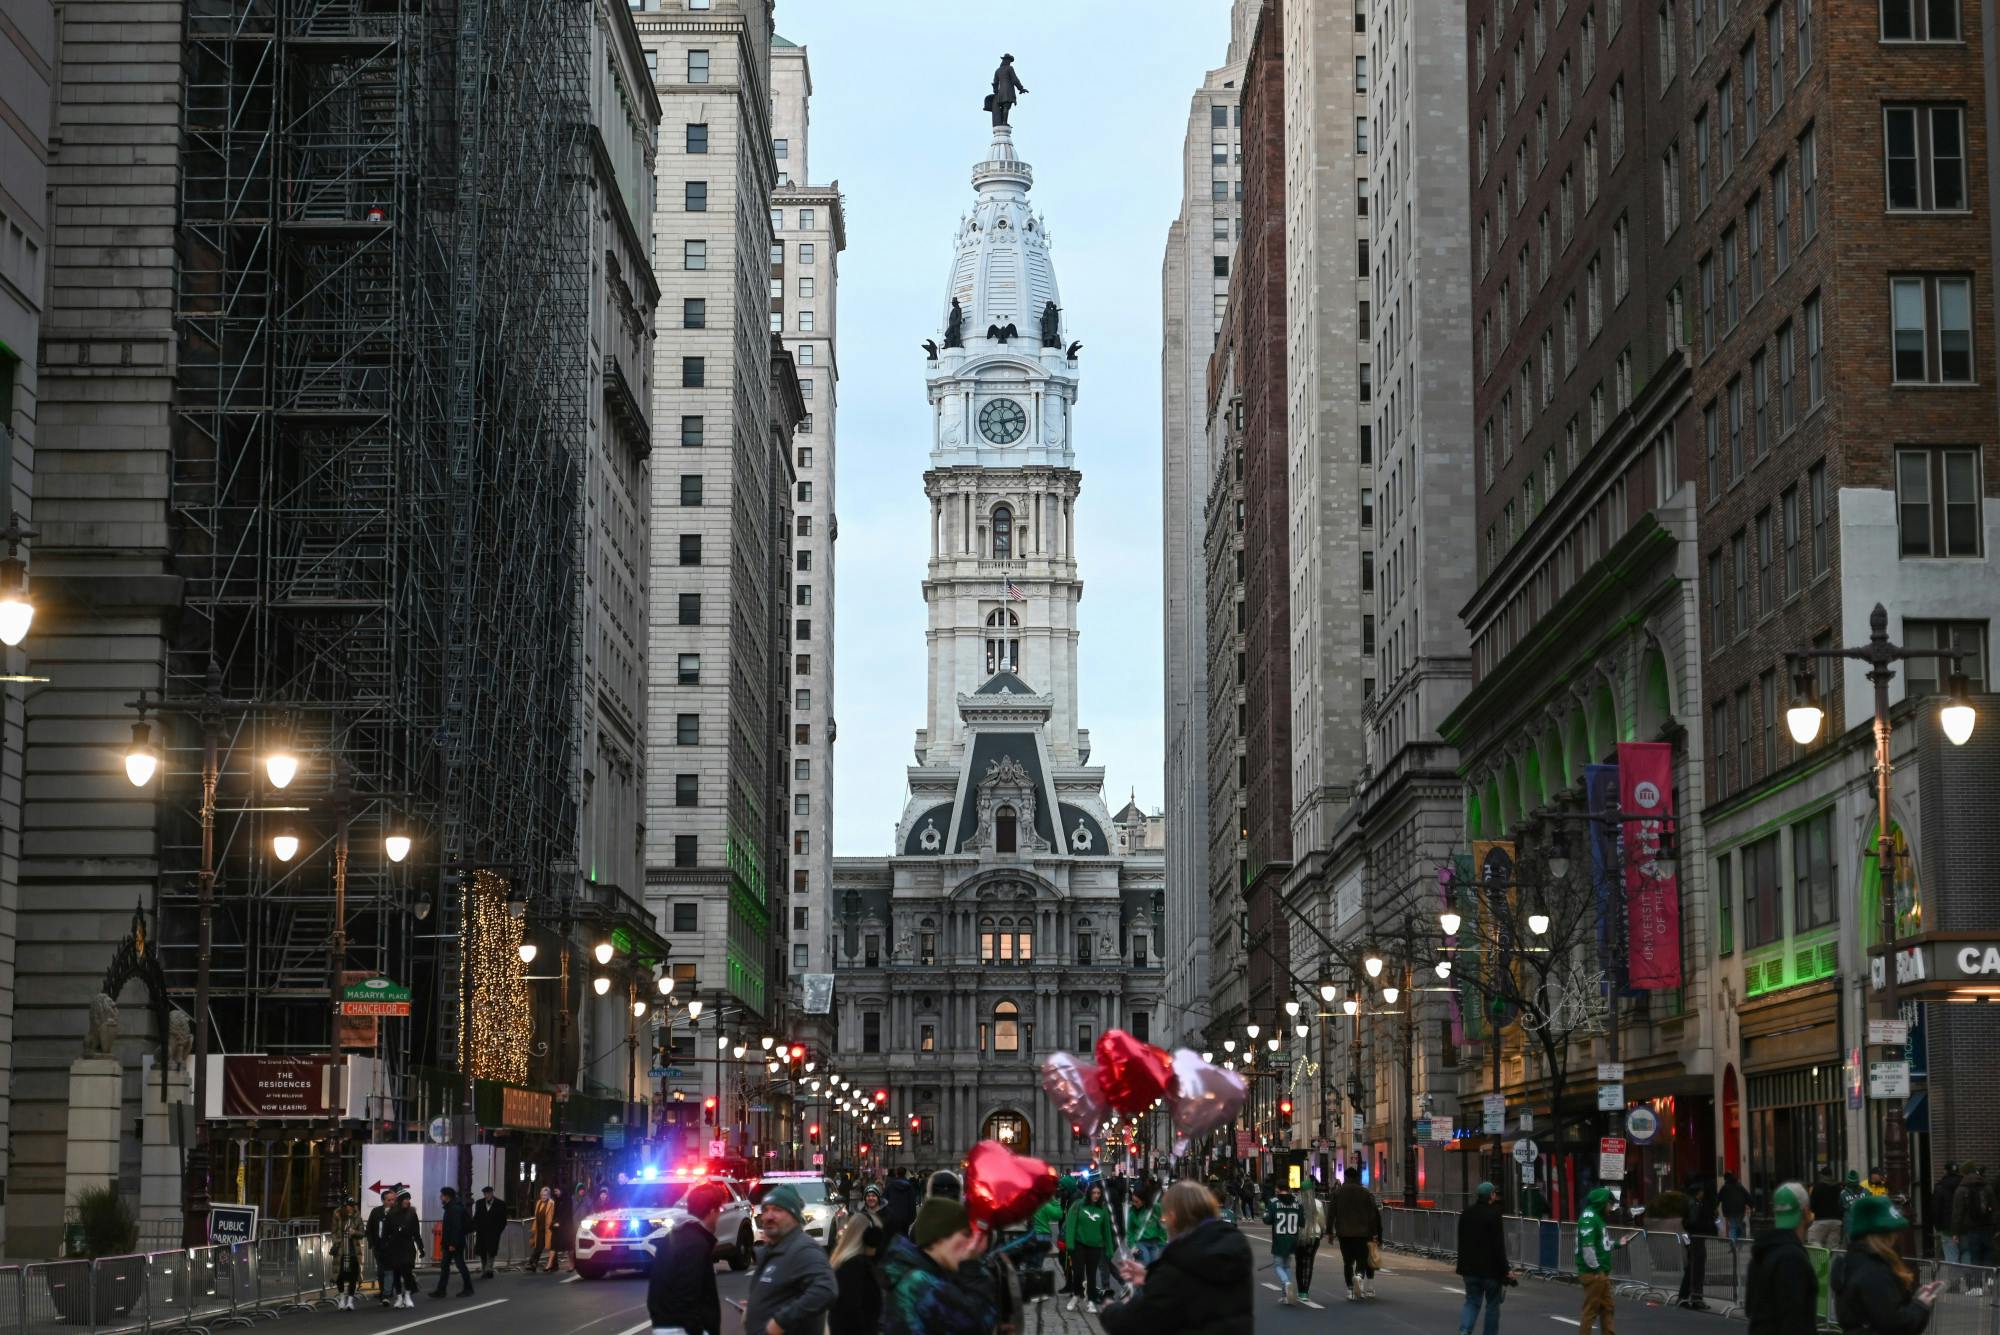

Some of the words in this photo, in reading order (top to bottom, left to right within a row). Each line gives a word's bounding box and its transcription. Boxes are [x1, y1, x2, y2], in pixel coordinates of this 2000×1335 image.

[1655, 887, 1665, 912] THE
[1656, 916, 1667, 934] OF
[1871, 946, 1925, 991] CABRIA
[347, 991, 385, 999] MASARYK
[347, 1004, 397, 1014] CHANCELLOR
[218, 1220, 245, 1232] PUBLIC
[1276, 1212, 1299, 1234] 20
